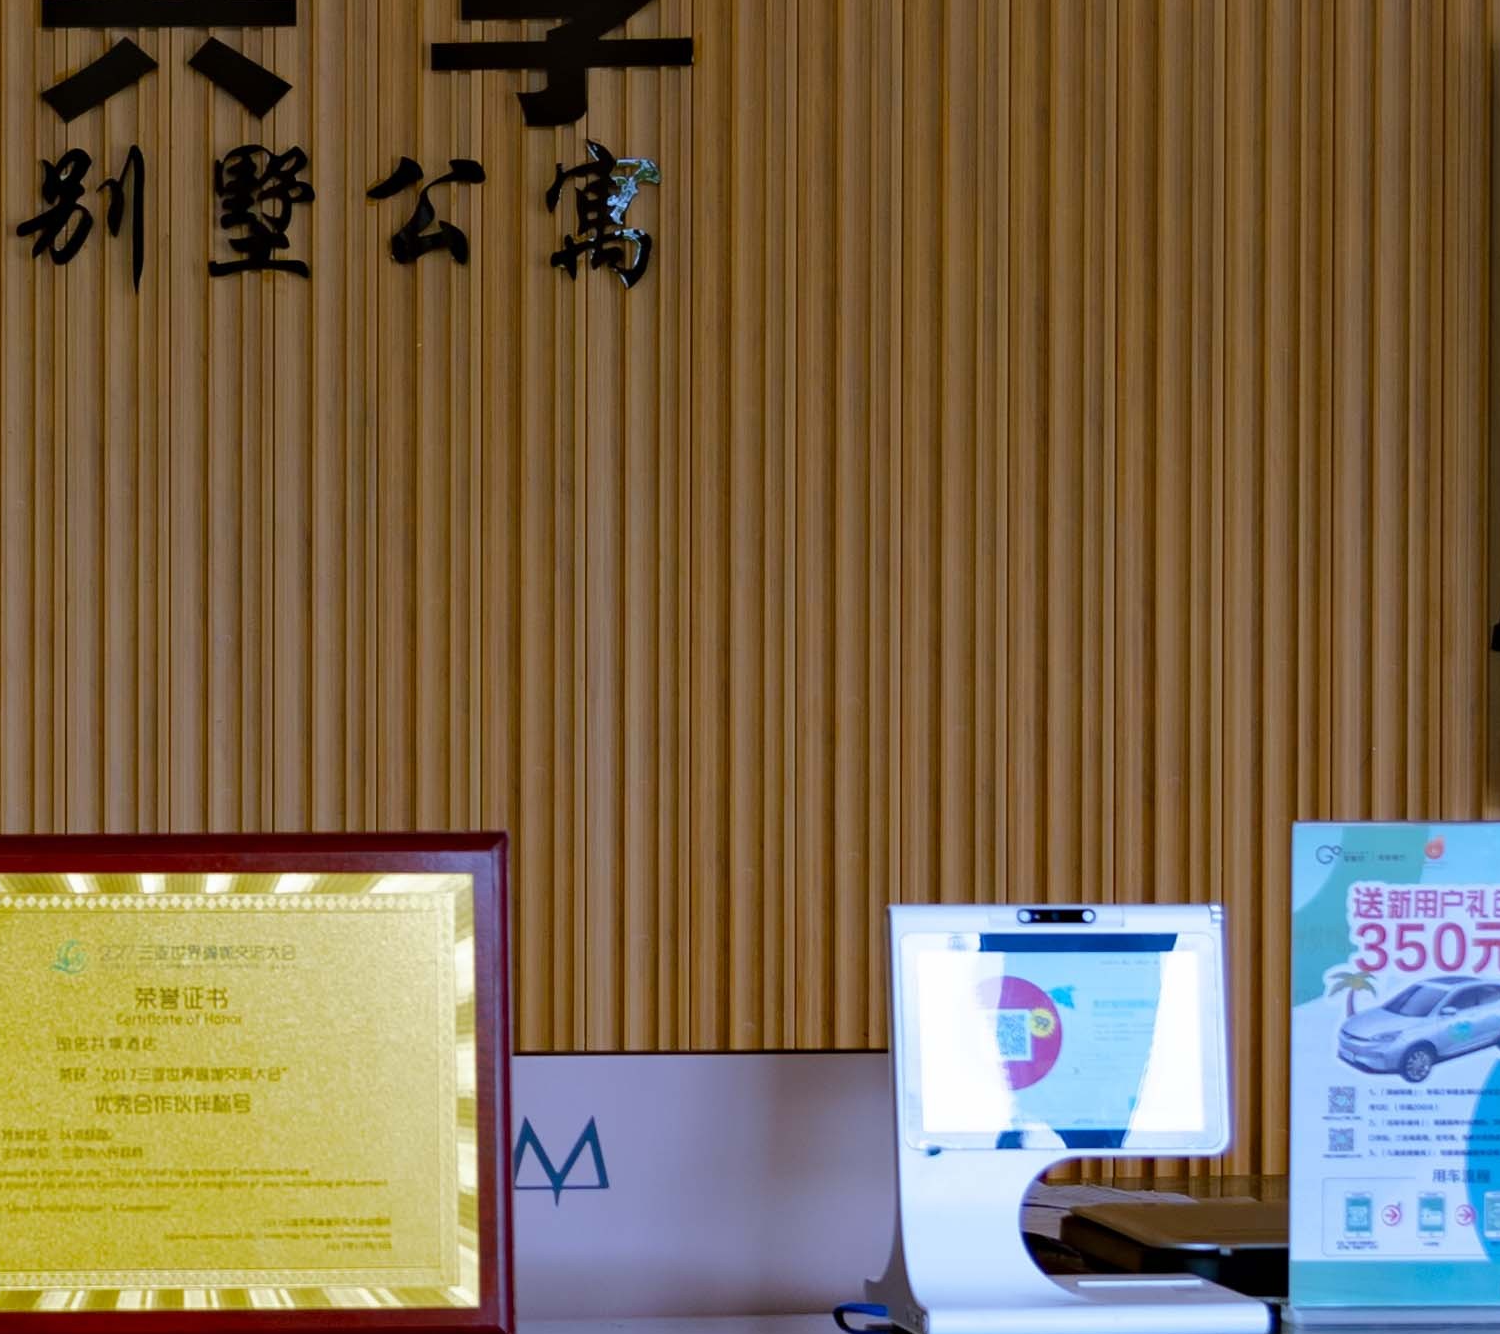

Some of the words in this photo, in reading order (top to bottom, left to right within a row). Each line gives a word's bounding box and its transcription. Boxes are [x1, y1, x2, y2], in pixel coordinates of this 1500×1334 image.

[13, 139, 661, 290] 别墅公寓
[135, 986, 229, 1010] 荣誉证书
